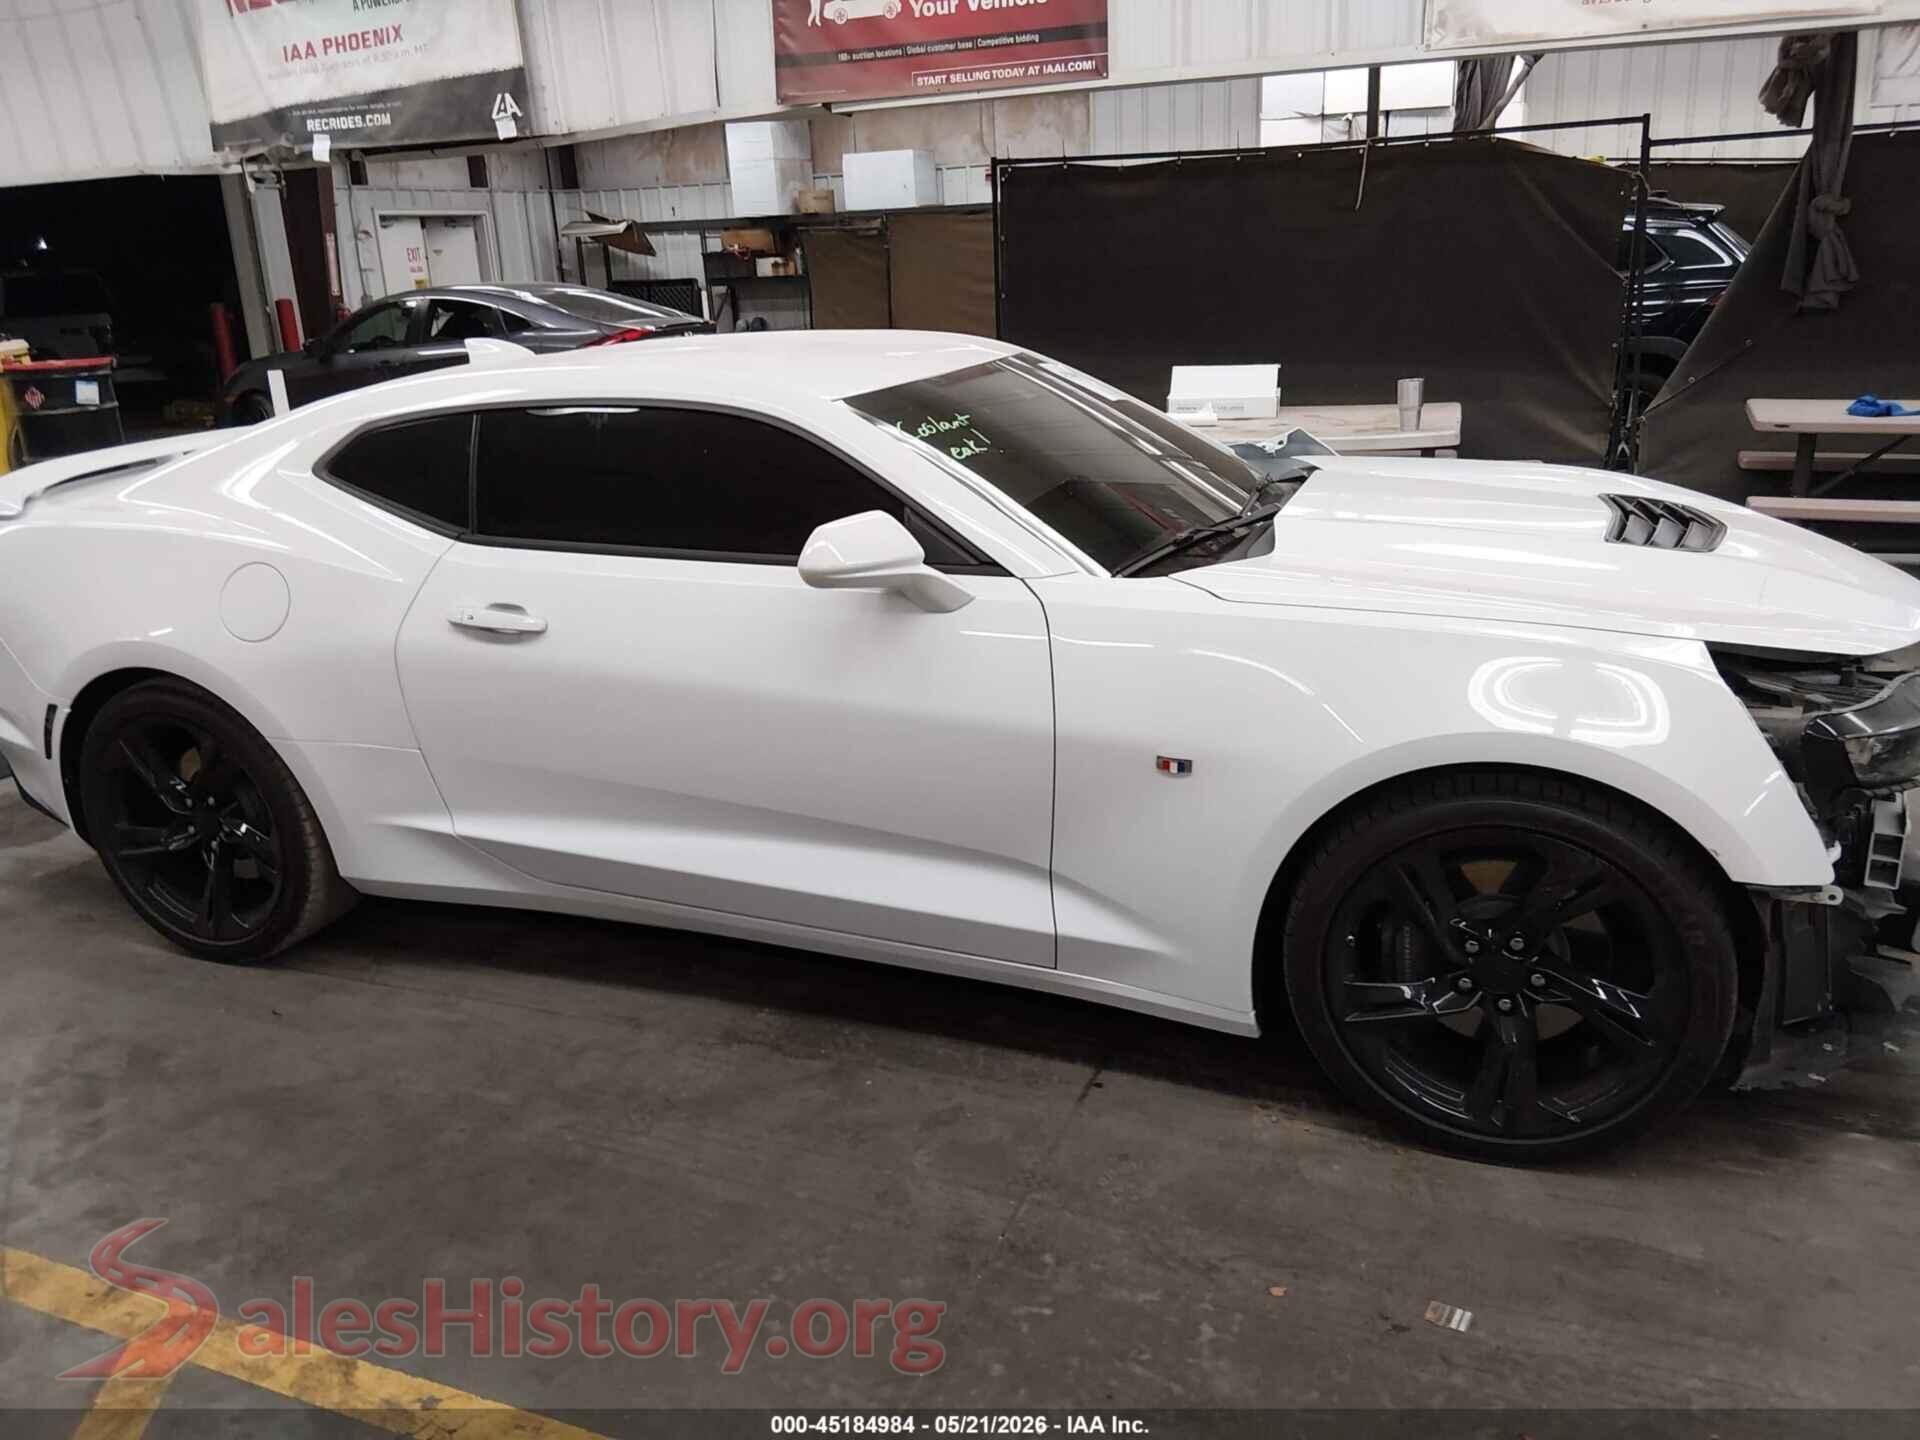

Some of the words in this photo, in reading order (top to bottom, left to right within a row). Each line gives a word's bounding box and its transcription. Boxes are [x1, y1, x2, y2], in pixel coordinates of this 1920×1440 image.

[908, 0, 960, 18] Your
[283, 40, 317, 63] IAA
[322, 23, 404, 56] PHOENIX
[916, 75, 947, 87] START
[949, 71, 991, 84] SELLING
[991, 67, 1025, 79] TODAY
[1027, 65, 1040, 76] AT
[306, 112, 392, 132] RECRIDES.COM
[950, 428, 1004, 461] eak!
